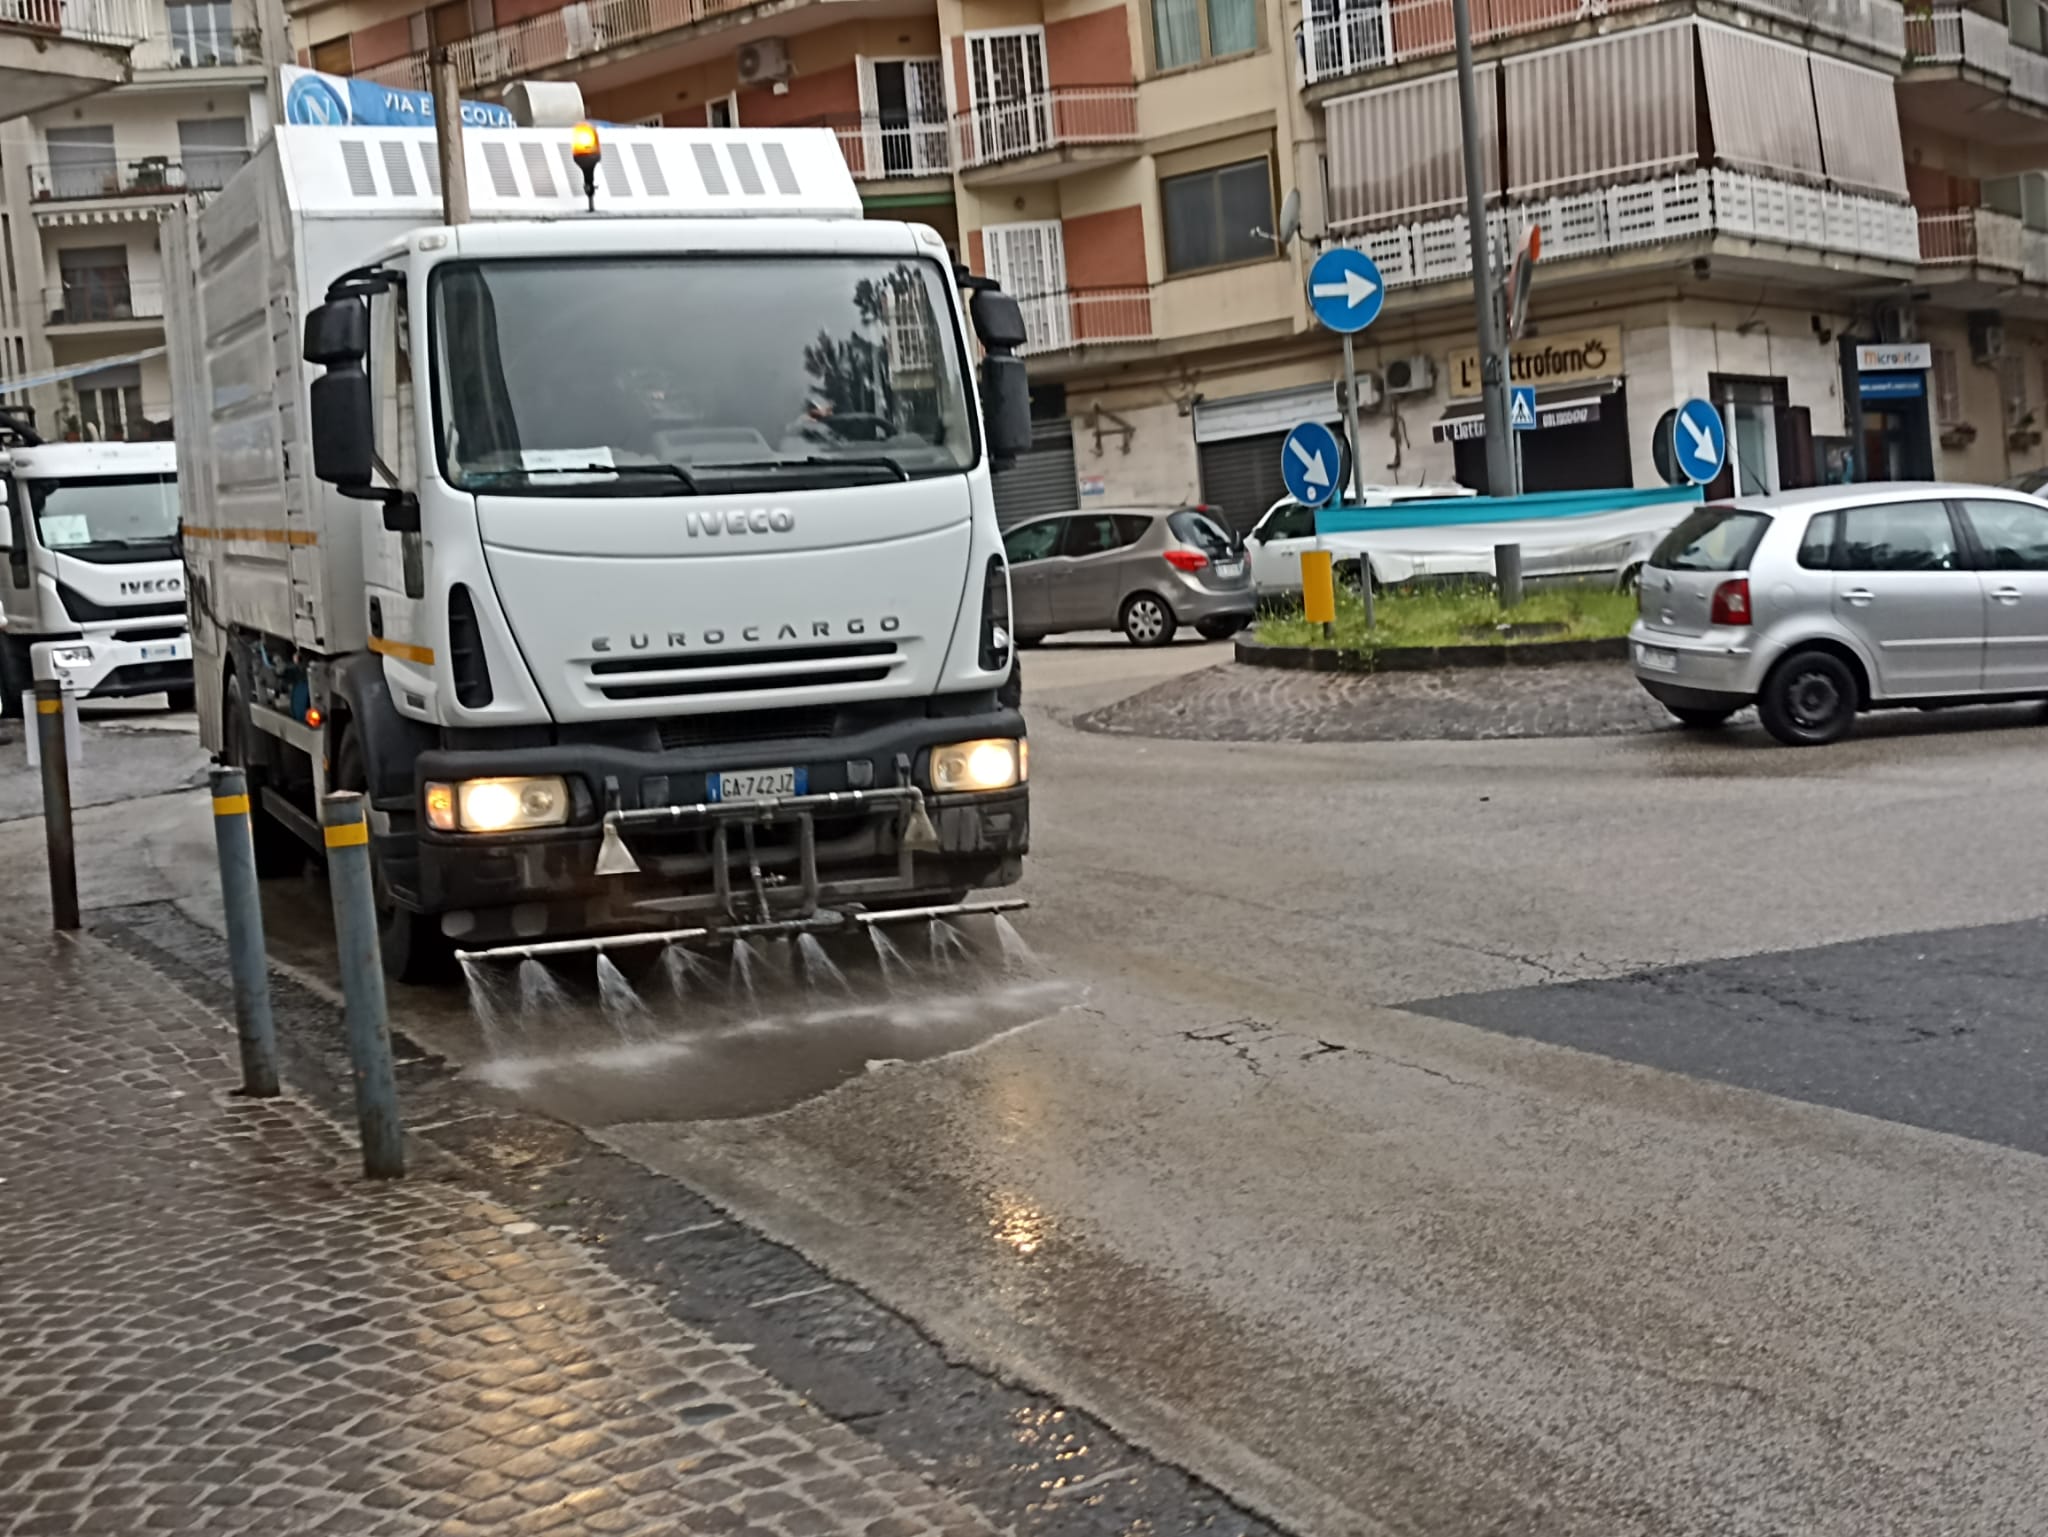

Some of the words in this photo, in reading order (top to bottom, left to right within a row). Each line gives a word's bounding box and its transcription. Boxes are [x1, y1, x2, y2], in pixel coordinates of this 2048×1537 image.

[384, 92, 415, 114] VIA
[686, 507, 795, 538] IVECO
[120, 578, 181, 596] IVECO
[591, 616, 900, 652] EUROCARGO
